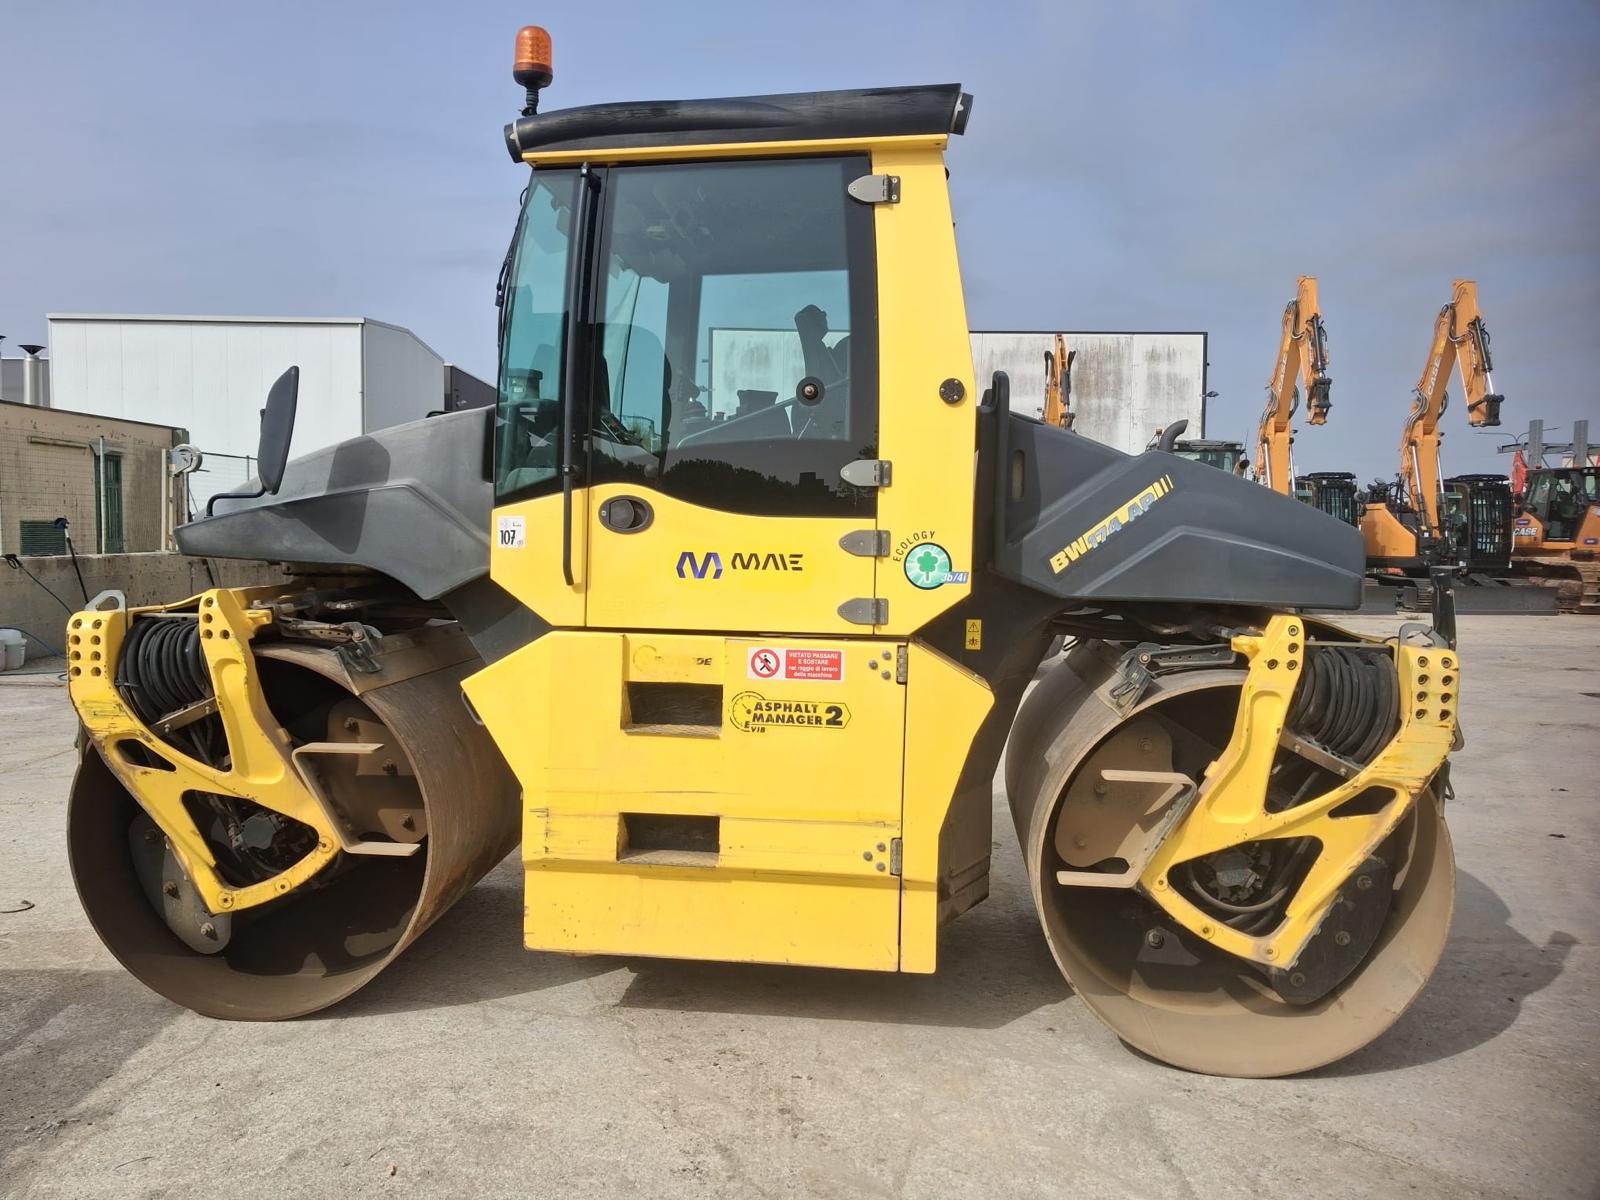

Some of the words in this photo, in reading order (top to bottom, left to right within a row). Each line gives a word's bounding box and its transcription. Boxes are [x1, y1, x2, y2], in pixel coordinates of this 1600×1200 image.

[1427, 355, 1441, 395] CASE
[500, 529, 516, 545] 107
[1513, 527, 1537, 537] CASE
[893, 530, 935, 562] ECOLOGY
[752, 713, 823, 726] MANAGER
[754, 701, 819, 714] ASPHALT
[825, 705, 843, 726] 2
